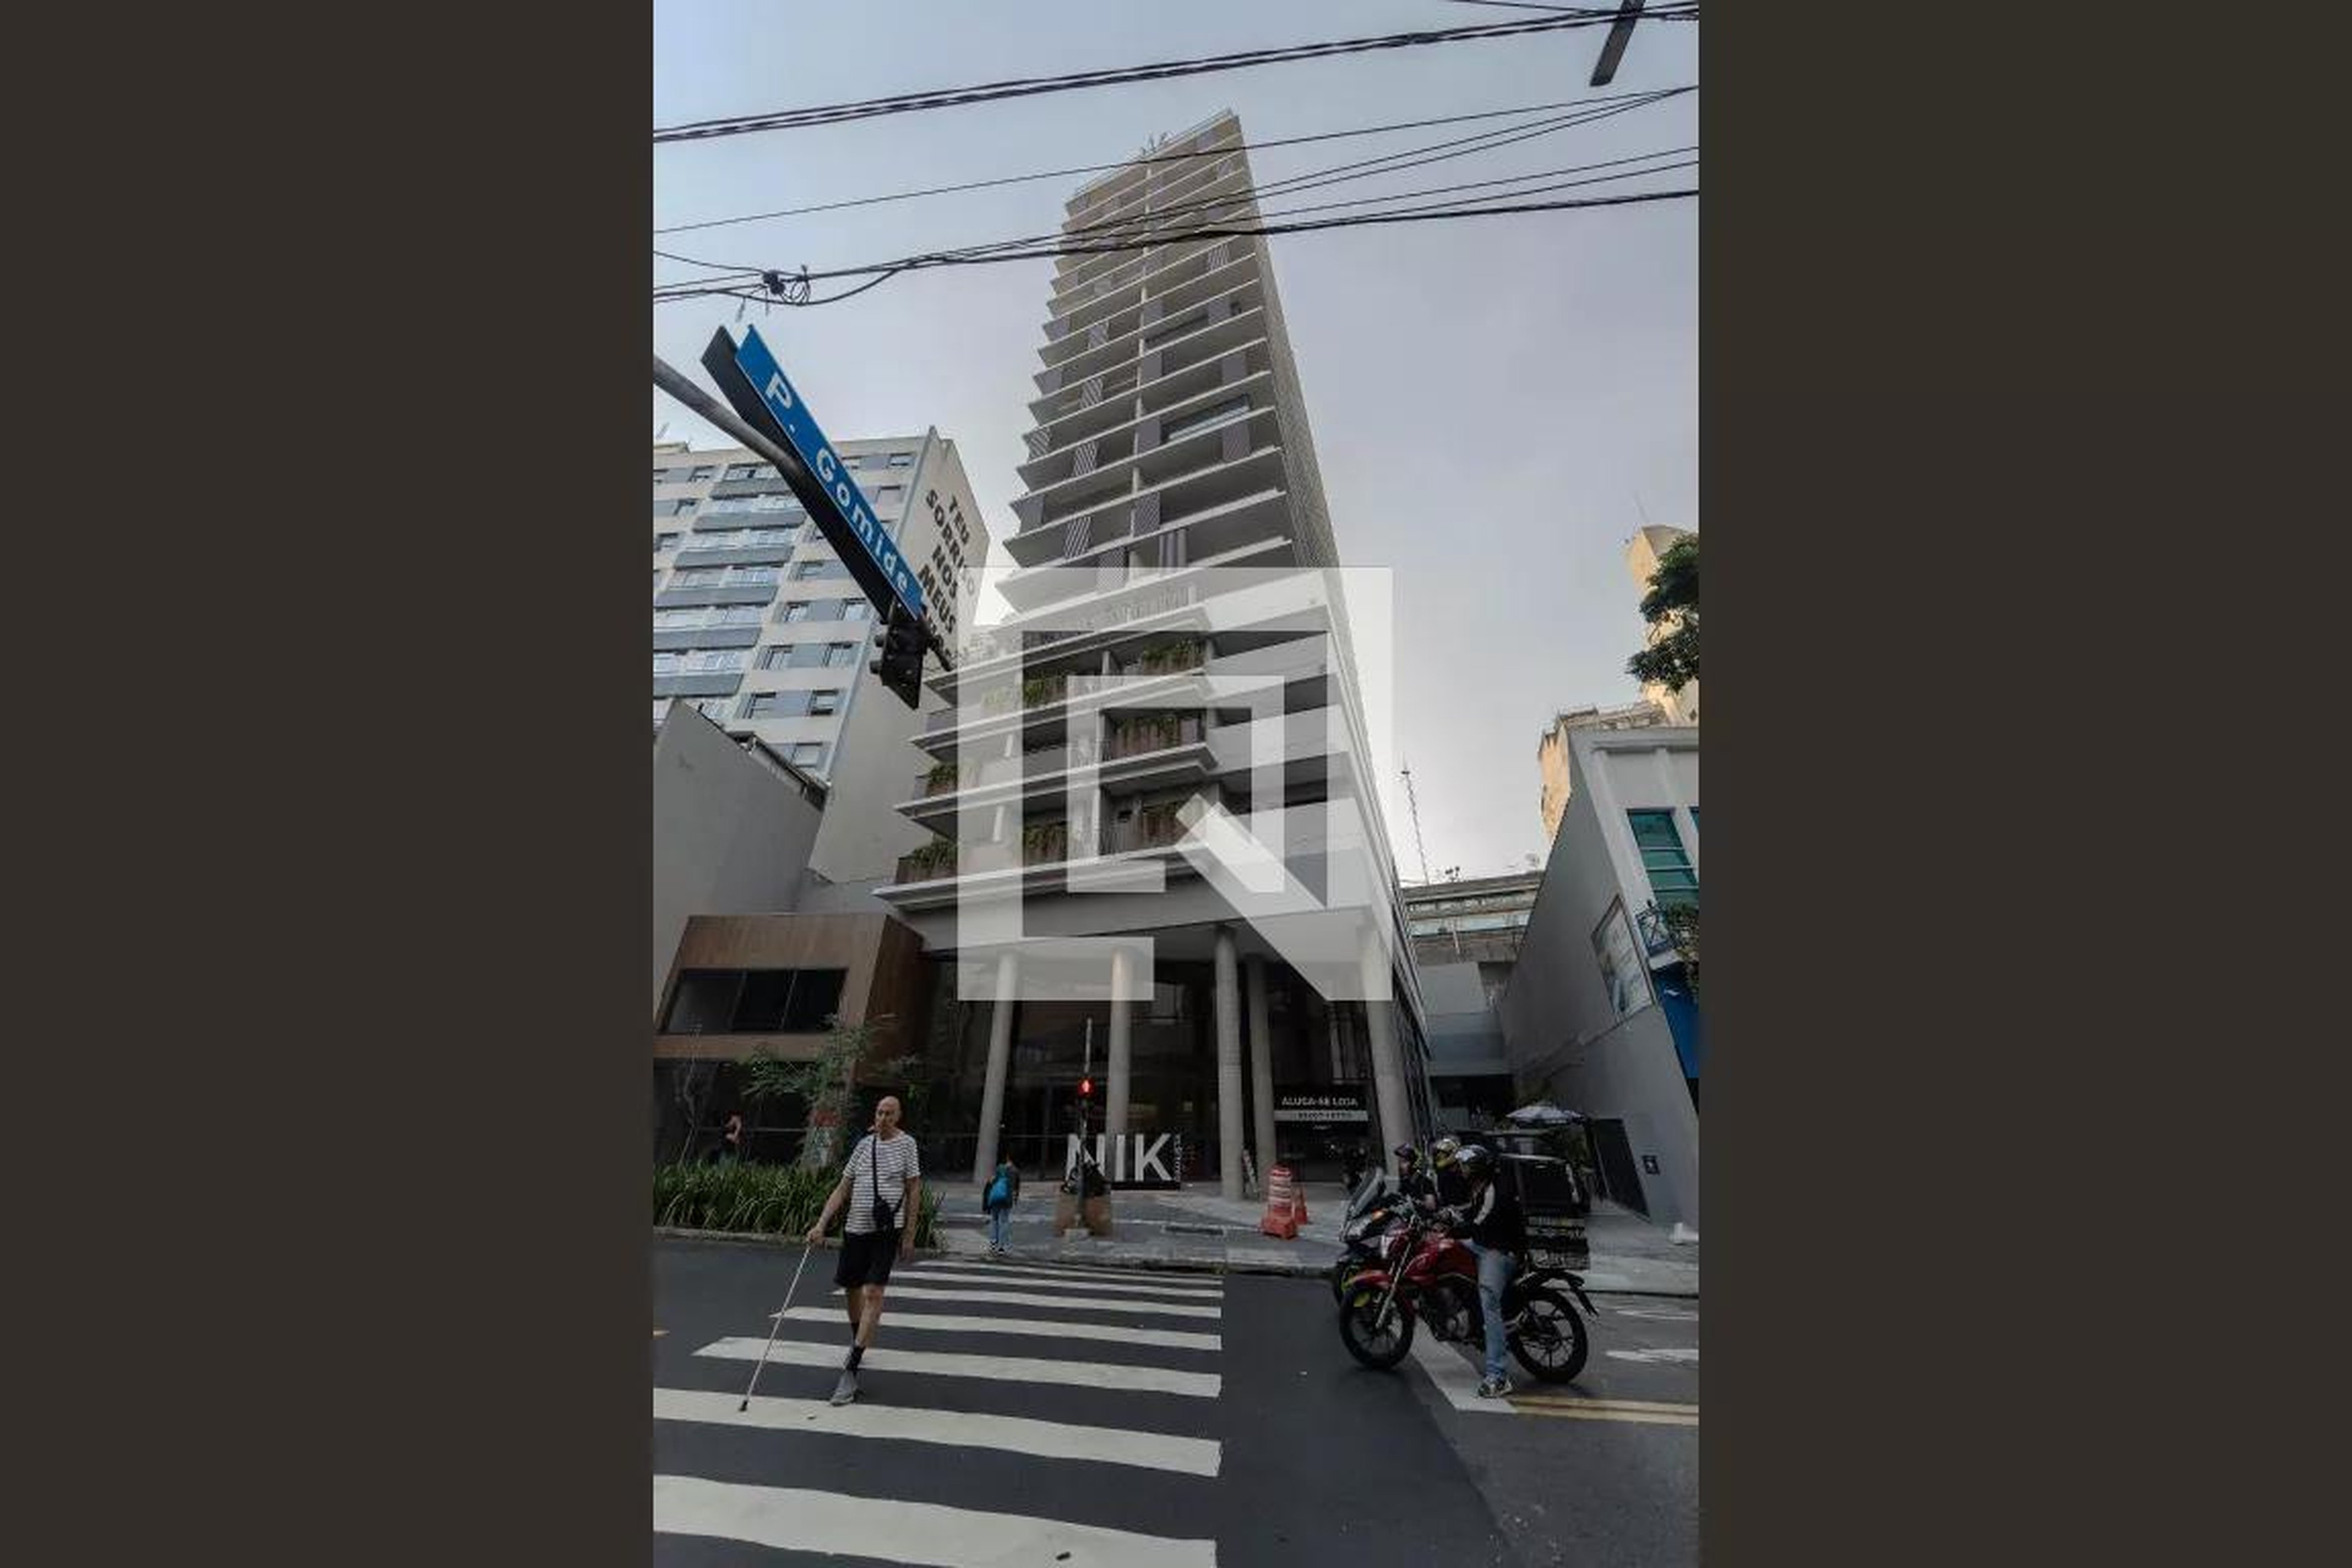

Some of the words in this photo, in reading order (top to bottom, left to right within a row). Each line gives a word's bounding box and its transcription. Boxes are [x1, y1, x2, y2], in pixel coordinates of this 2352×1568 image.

[816, 447, 908, 594] Gomide
[925, 489, 974, 597] SORRIO
[949, 494, 970, 545] TEU
[918, 564, 956, 633] MEUS
[931, 544, 957, 599] NOS
[1065, 1134, 1172, 1182] NIK
